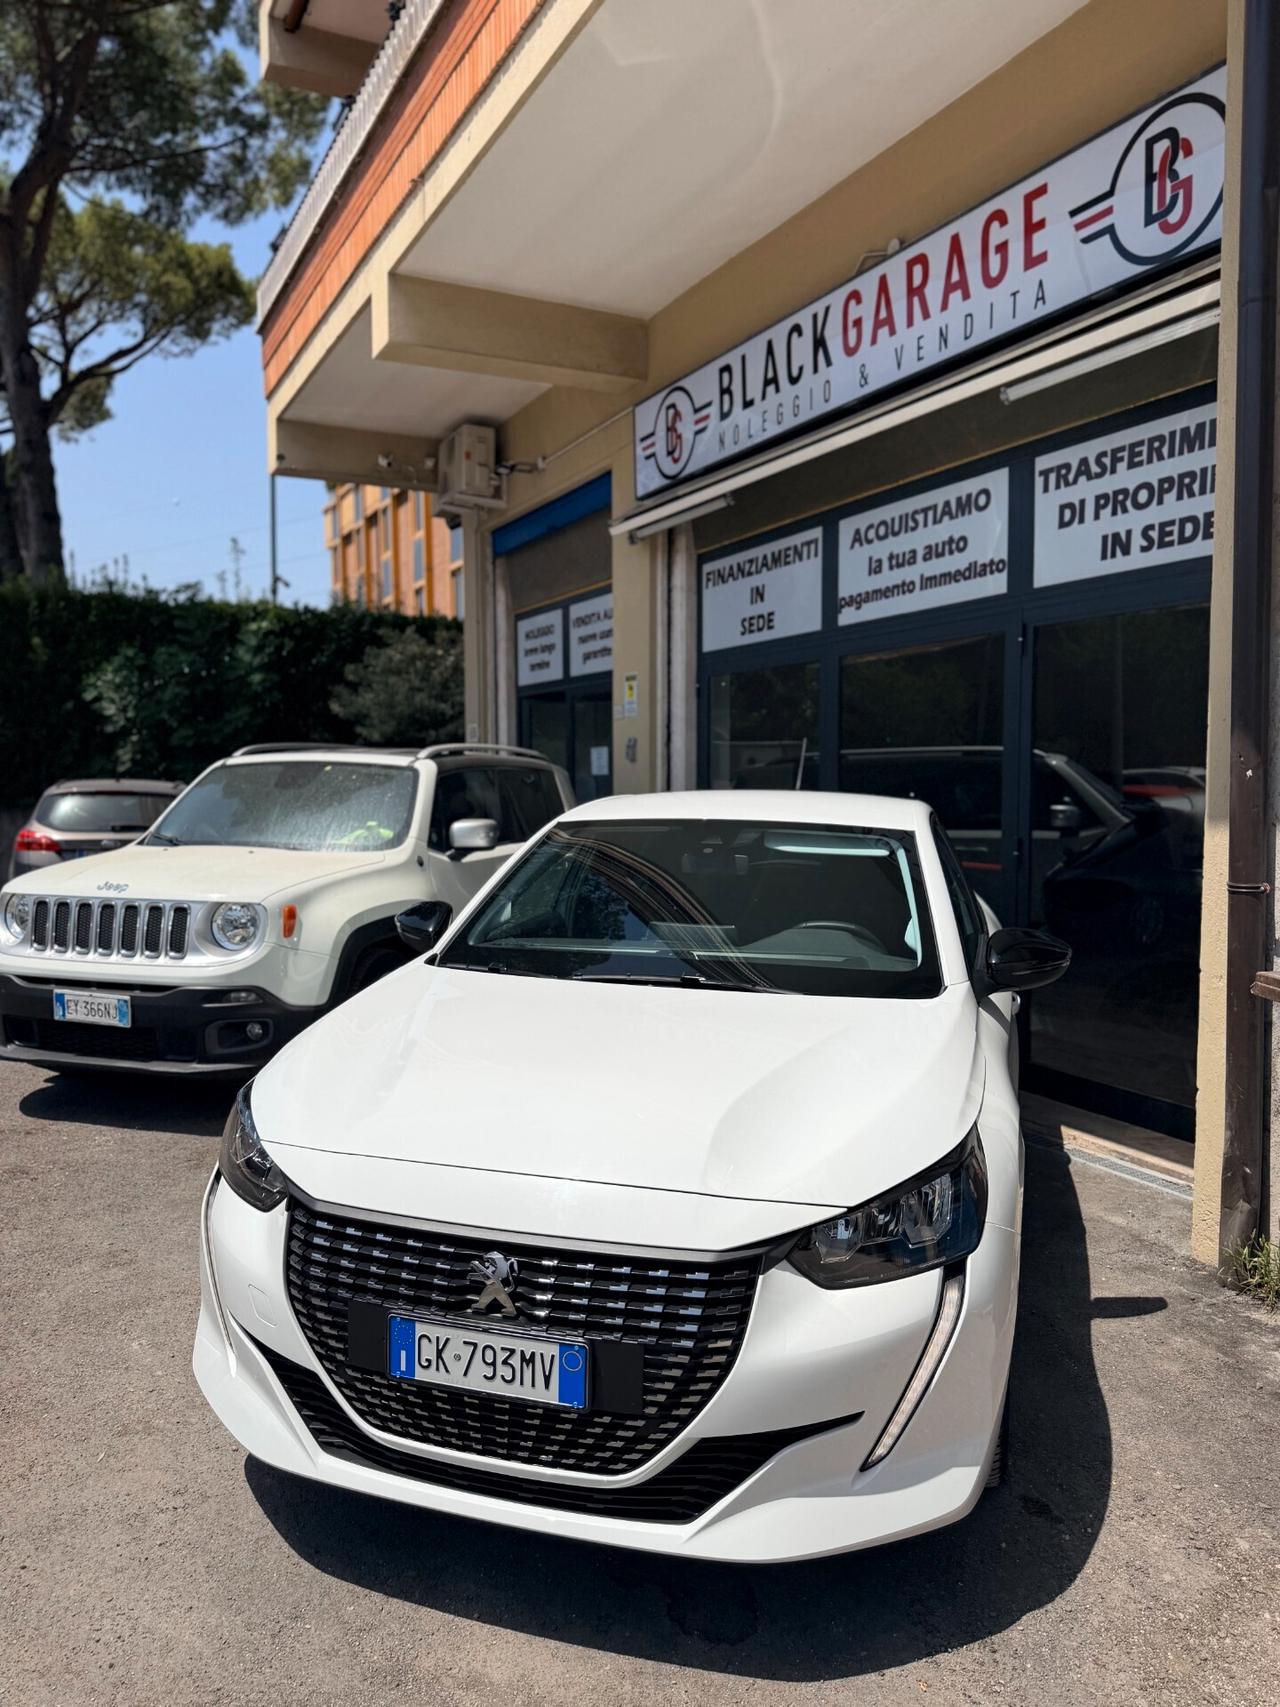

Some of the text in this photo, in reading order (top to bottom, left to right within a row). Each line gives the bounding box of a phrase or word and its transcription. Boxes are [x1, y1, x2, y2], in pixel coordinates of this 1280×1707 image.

[718, 278, 1046, 451] NOLEGGIO & VENDITA
[849, 488, 992, 551] ACQUISTIAMO
[1057, 498, 1086, 530] DI
[867, 533, 968, 577] la tua auto
[1100, 510, 1214, 562] IN SEDE
[705, 537, 820, 590] FINANZIAMENTI
[750, 584, 766, 606] IN
[838, 579, 916, 614] pagamento
[740, 611, 775, 637] SEDE
[96, 881, 129, 894] Jeep
